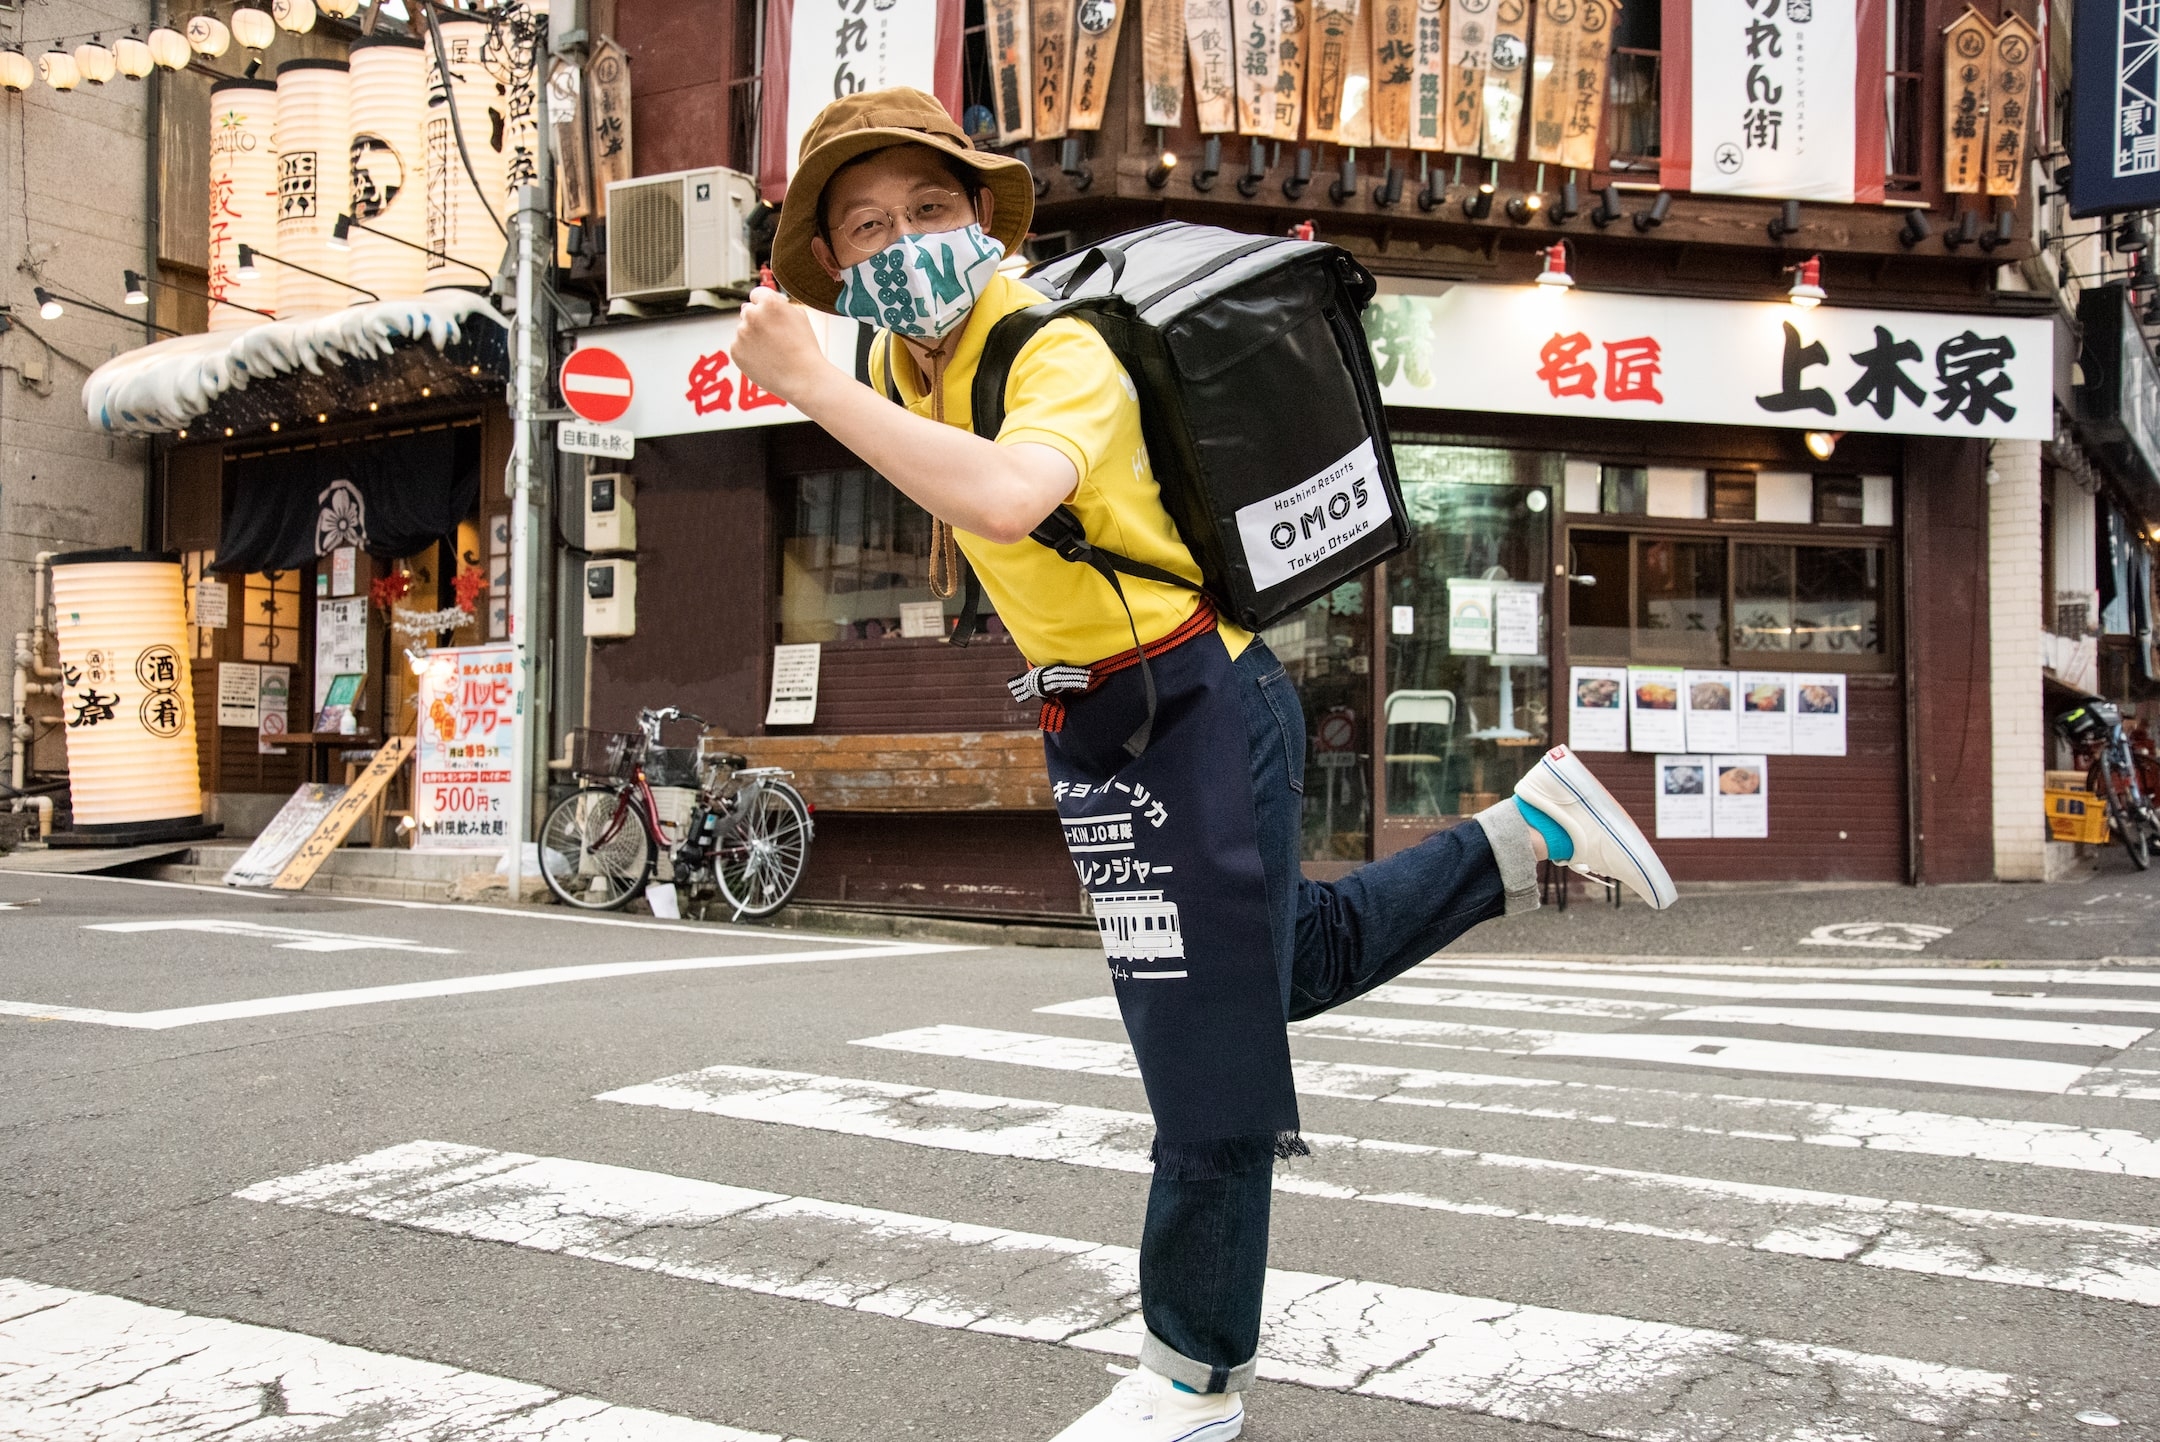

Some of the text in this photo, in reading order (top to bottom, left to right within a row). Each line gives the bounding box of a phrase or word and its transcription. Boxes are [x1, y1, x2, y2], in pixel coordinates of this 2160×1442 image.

[1996, 98, 2024, 183] 魚寿司
[1536, 331, 1663, 405] 名匠
[1755, 319, 2017, 426] 上木家
[563, 429, 630, 453] 自転車を除く
[1274, 461, 1355, 512] Hoshino Resorts
[1270, 476, 1369, 550] OMO5
[1287, 519, 1370, 571] Tokyo Otsuka
[149, 654, 179, 729] 酒肴
[462, 677, 513, 707] ハッピー
[462, 708, 513, 737] アワー
[433, 786, 501, 813] 500円で
